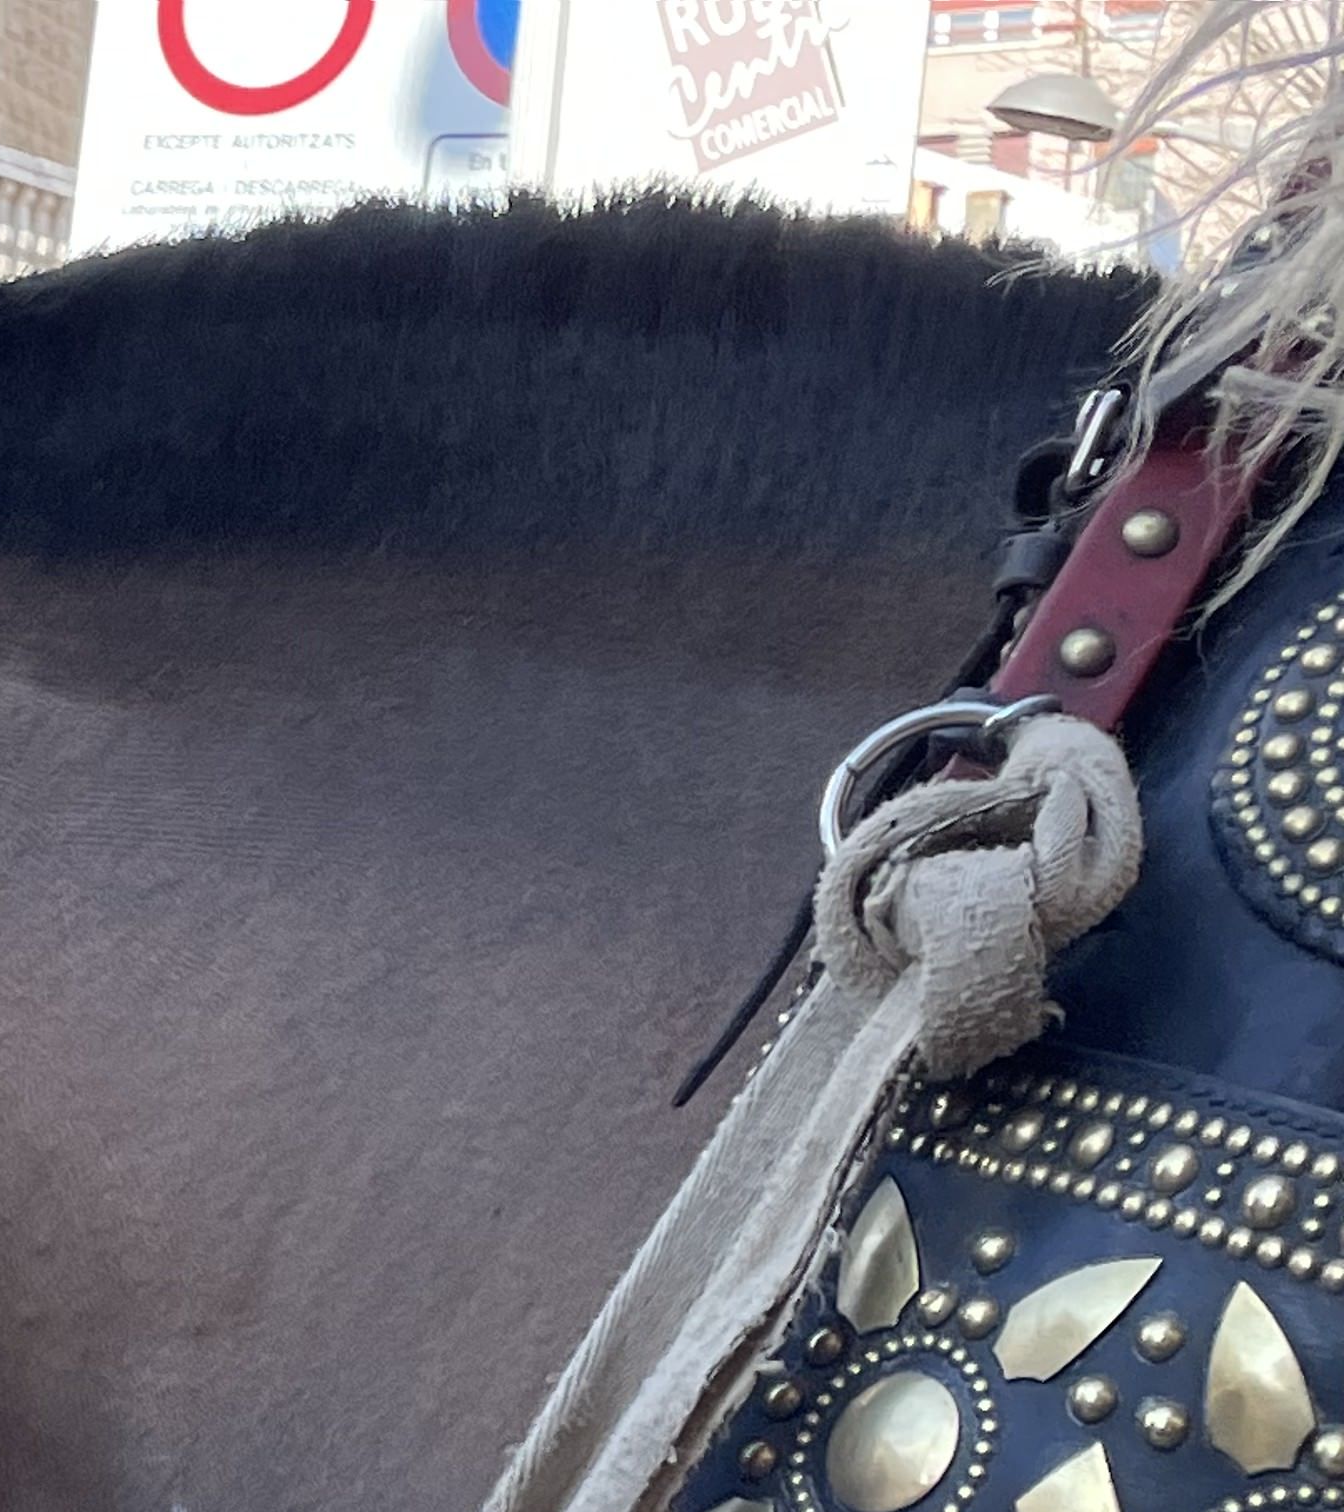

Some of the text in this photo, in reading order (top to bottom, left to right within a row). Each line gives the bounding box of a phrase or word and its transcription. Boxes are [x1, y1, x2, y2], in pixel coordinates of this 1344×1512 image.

[700, 86, 835, 161] COMERCIAL
[143, 132, 355, 149] EXCEPTE AUTORITZATS
[130, 179, 214, 196] CARREGA
[233, 178, 355, 196] DESCARREGA
